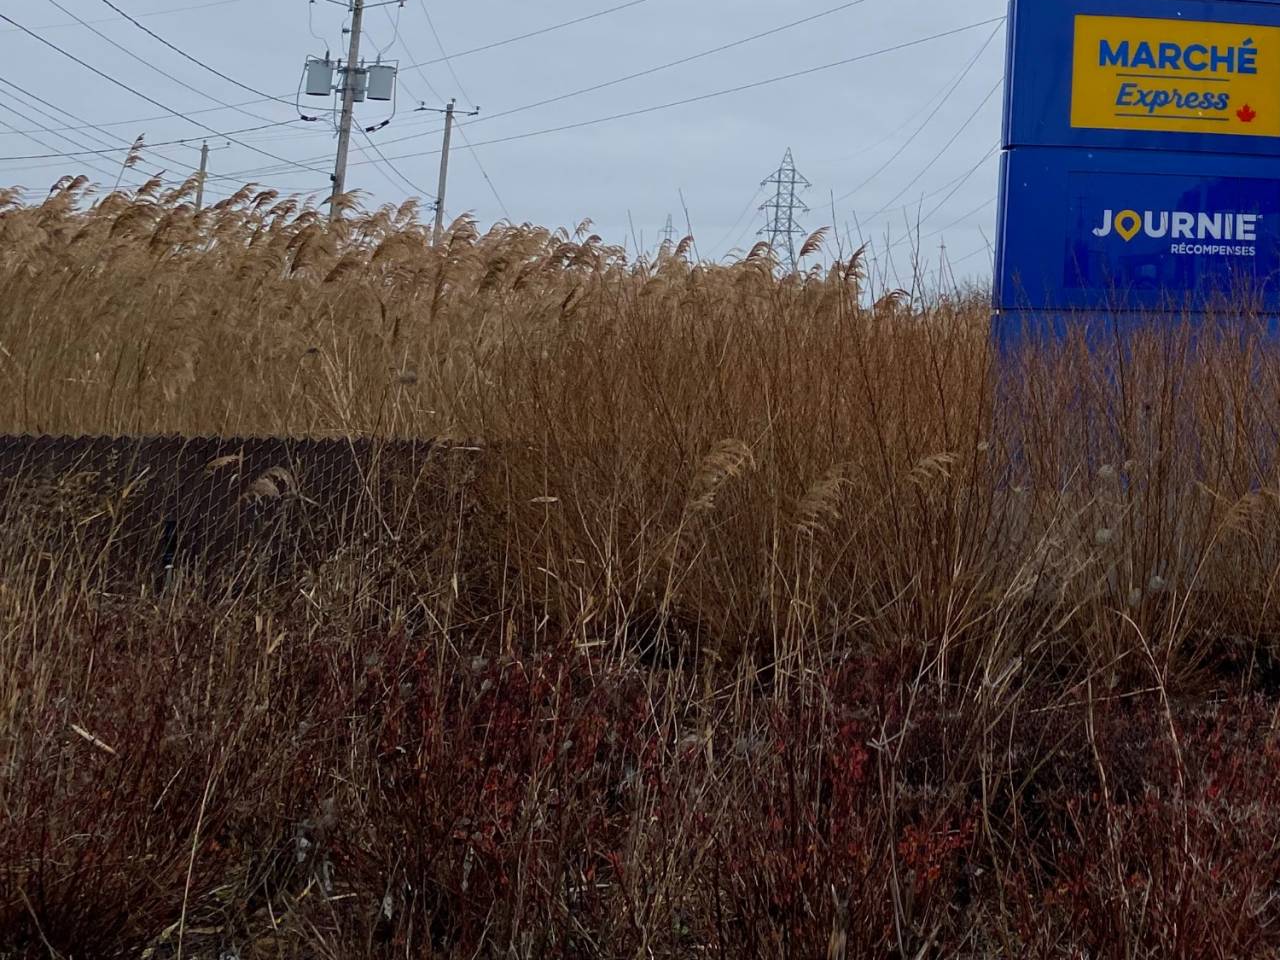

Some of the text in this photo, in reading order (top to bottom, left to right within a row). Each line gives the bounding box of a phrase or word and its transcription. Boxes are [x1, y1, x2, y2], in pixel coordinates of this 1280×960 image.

[1098, 37, 1259, 75] MARCHÉ
[1115, 82, 1231, 113] Express
[1092, 209, 1258, 242] JOURNIE
[1170, 242, 1256, 256] RÉCOMPENSES
